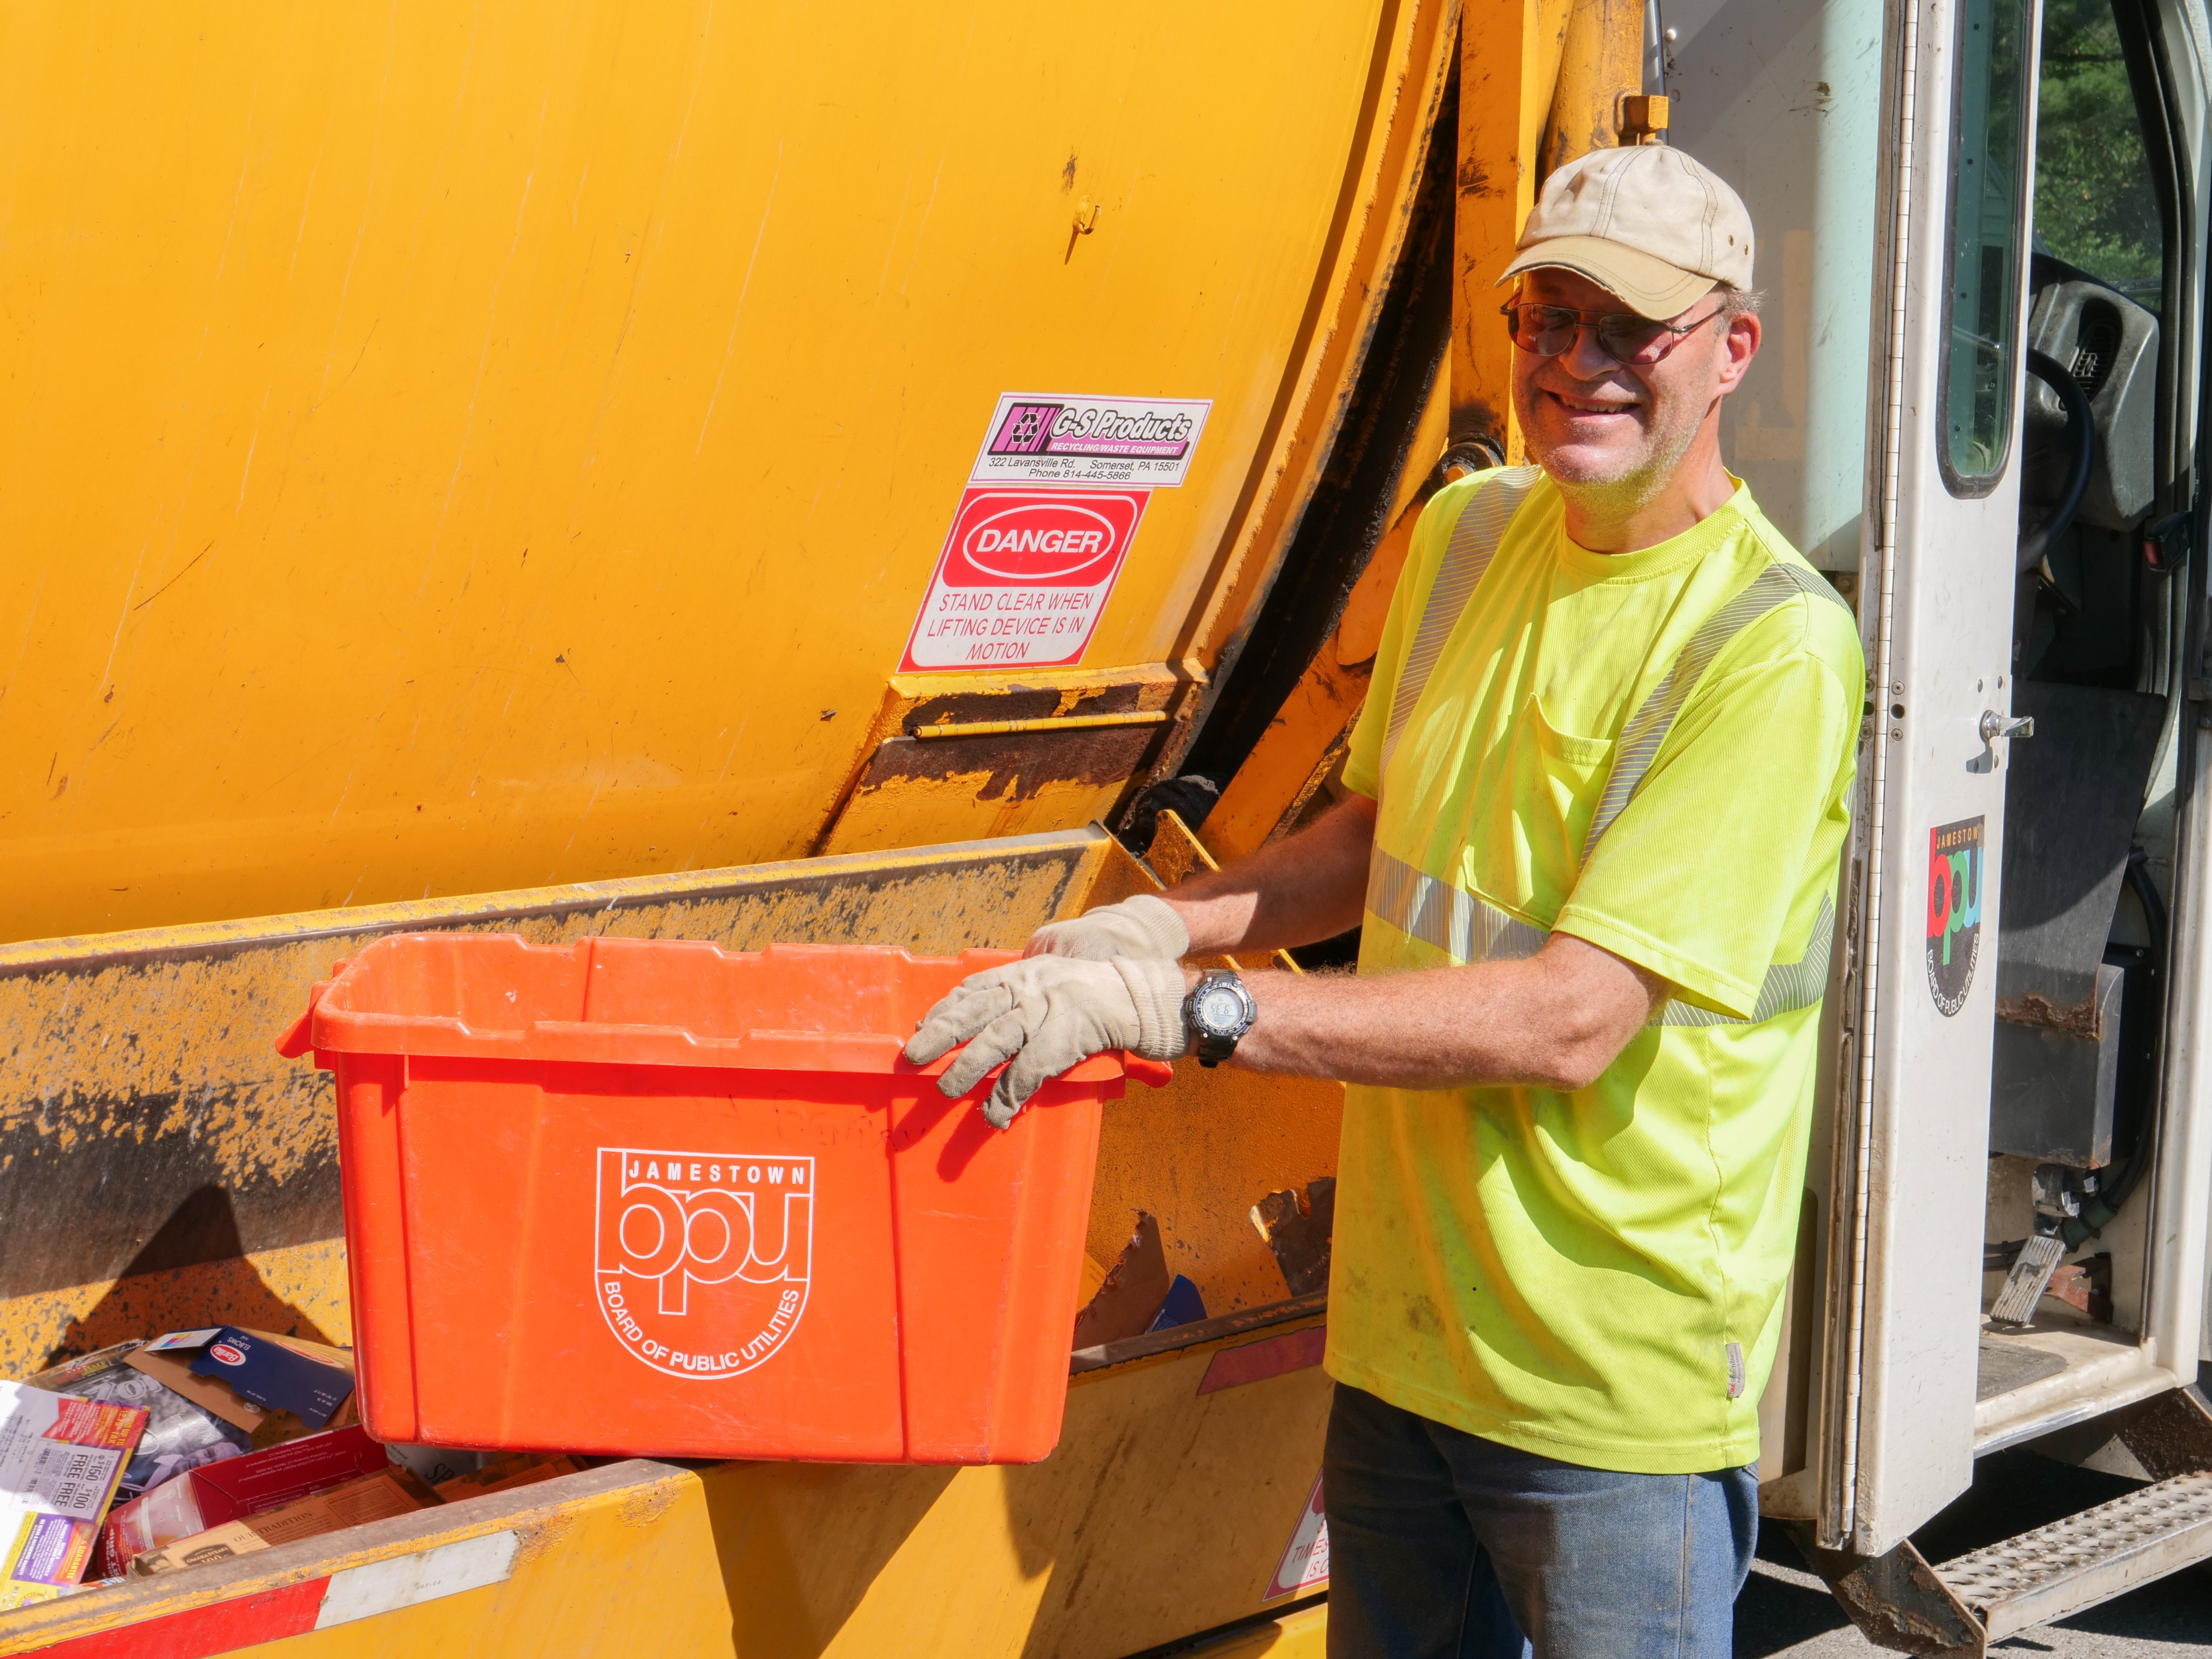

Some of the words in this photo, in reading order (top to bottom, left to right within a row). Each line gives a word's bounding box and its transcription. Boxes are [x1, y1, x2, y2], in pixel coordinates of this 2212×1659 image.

[1050, 408, 1096, 439] G-S
[1092, 409, 1193, 443] Products
[1051, 442, 1130, 453] RECYCLING/WASTE
[1130, 445, 1179, 454] EQUIPMENT
[989, 457, 1006, 467] 322
[1008, 457, 1058, 468] Lavansville
[1060, 458, 1076, 468] Rd.
[1090, 460, 1135, 471] Somerset,
[1138, 461, 1151, 470] PA
[1154, 462, 1179, 471] 15501
[1029, 469, 1061, 478] Phone
[1063, 470, 1131, 480] 814-445-5866
[976, 530, 1103, 553] DANGER
[939, 594, 993, 611] STAND
[997, 593, 1044, 610] CLEAR
[1049, 592, 1094, 610] WHEN
[927, 618, 987, 636] LIFTING
[990, 617, 1049, 635] DEVICE
[1052, 617, 1066, 633] IS
[1068, 617, 1085, 633] IN
[966, 642, 1030, 660] MOTION
[1937, 826, 1978, 849] JAMESTOW
[1927, 949, 1938, 999] BOARD
[1937, 996, 1946, 1010] OF
[1944, 990, 1964, 1015] PUBLIC
[1963, 933, 1979, 996] UTILITIES
[629, 1161, 804, 1184] JAMESTOWN
[595, 1147, 814, 1316] bpu
[605, 1281, 643, 1342] BOARD
[642, 1339, 669, 1360] OF
[670, 1351, 739, 1371] PUBLIC
[740, 1289, 799, 1360] UTILITIES
[212, 1346, 238, 1362] Barilla
[226, 1336, 251, 1351] ELBOWS
[107, 1431, 118, 1444] TAX
[120, 1428, 129, 1437] UP
[66, 1454, 88, 1479] FREE
[85, 1461, 104, 1482] $150
[54, 1482, 76, 1507] FREE
[72, 1488, 92, 1509] $100
[234, 1531, 256, 1542] OUR
[258, 1511, 312, 1534] TRADITION
[66, 1545, 86, 1579] GUARANTEE
[186, 1553, 209, 1563] OMAHA
[208, 1547, 228, 1557] STEAKS
[1306, 1561, 1320, 1578] IS
